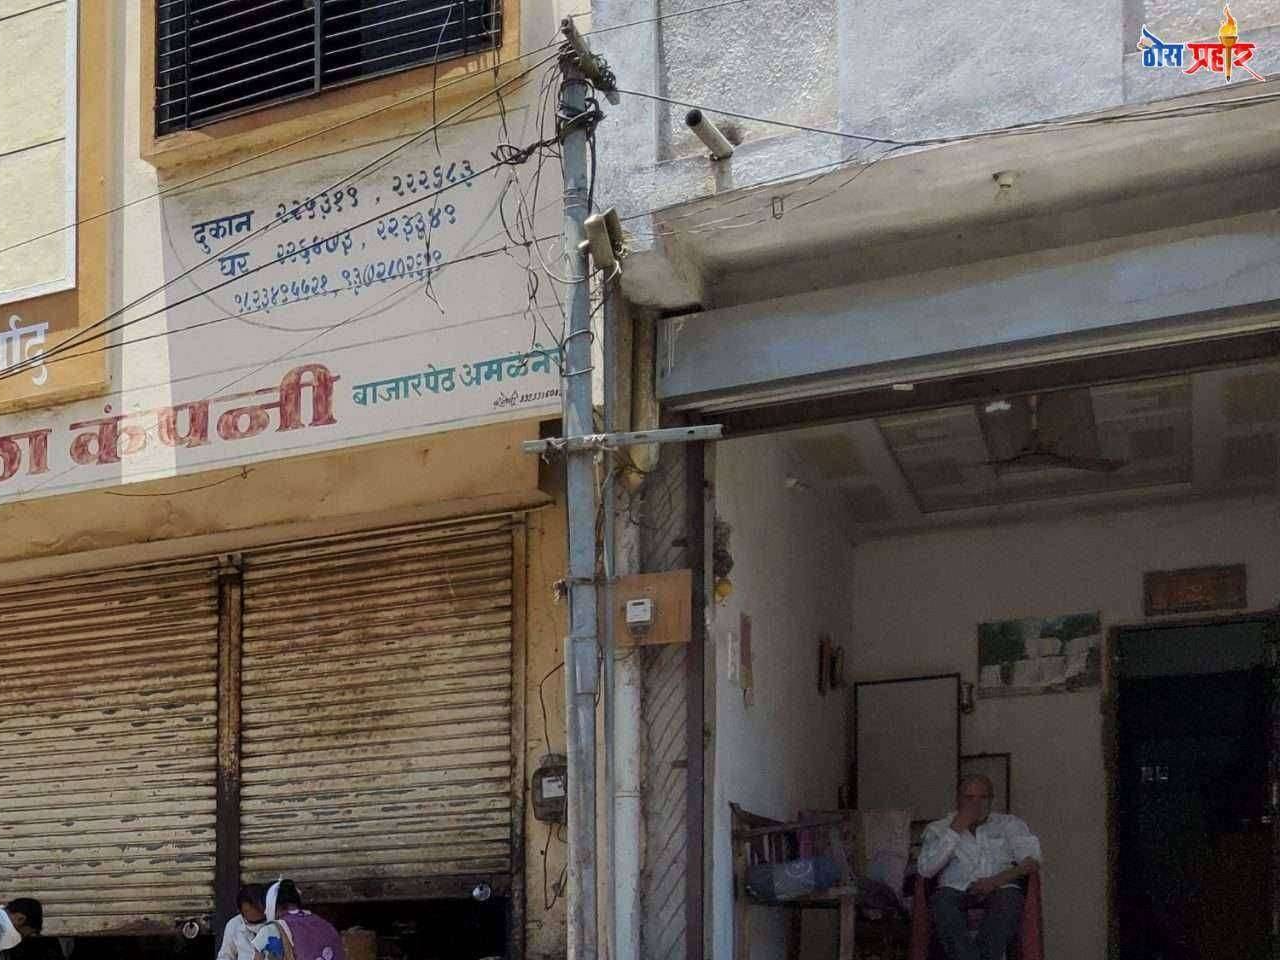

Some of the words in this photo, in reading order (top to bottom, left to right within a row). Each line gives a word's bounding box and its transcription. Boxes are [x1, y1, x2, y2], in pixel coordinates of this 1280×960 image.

[192, 210, 255, 255] दुकान
[219, 251, 250, 277] घर
[352, 362, 457, 406] बाजारपेठ
[69, 362, 342, 467] कंपनी
